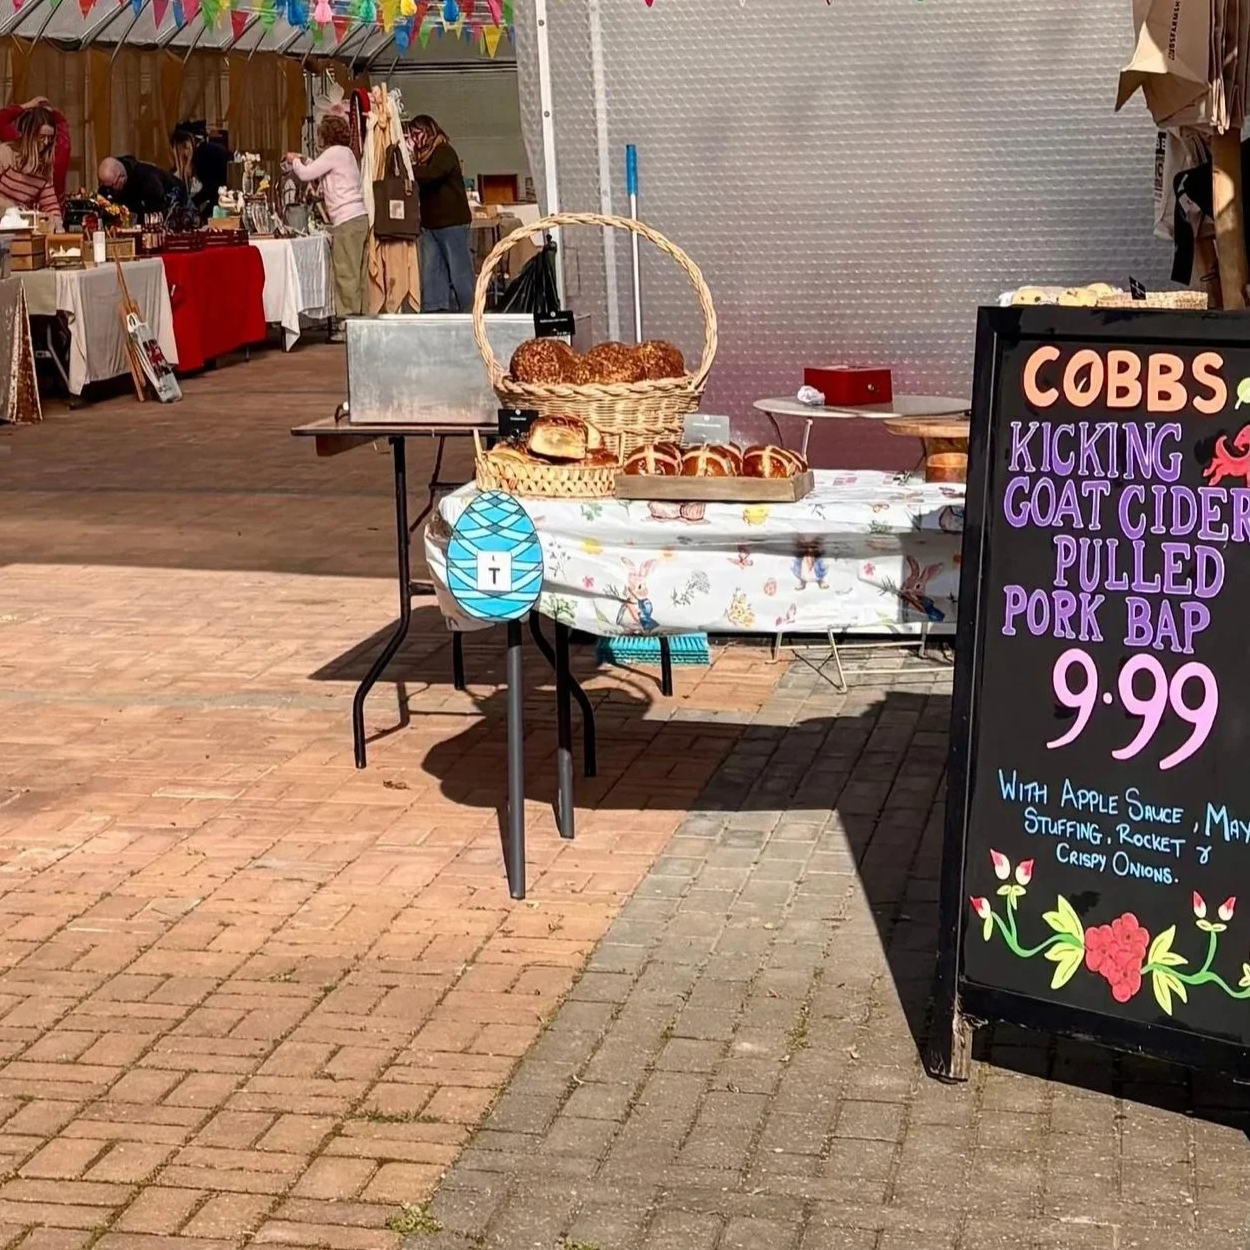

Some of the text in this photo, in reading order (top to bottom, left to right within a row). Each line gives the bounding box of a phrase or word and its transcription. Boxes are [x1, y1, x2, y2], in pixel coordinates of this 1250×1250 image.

[1023, 345, 1228, 415] COBBS
[1008, 421, 1183, 482] KICKING
[1003, 476, 1250, 542] GOAT CIDER
[1053, 534, 1226, 598] PULLED
[1001, 584, 1211, 654] PORK BAP
[1046, 648, 1219, 770] 9.99
[998, 768, 1048, 805] WITH
[1060, 778, 1119, 815] APPLE
[1056, 842, 1107, 872] CRISPY
[1116, 823, 1187, 858] ROCKET
